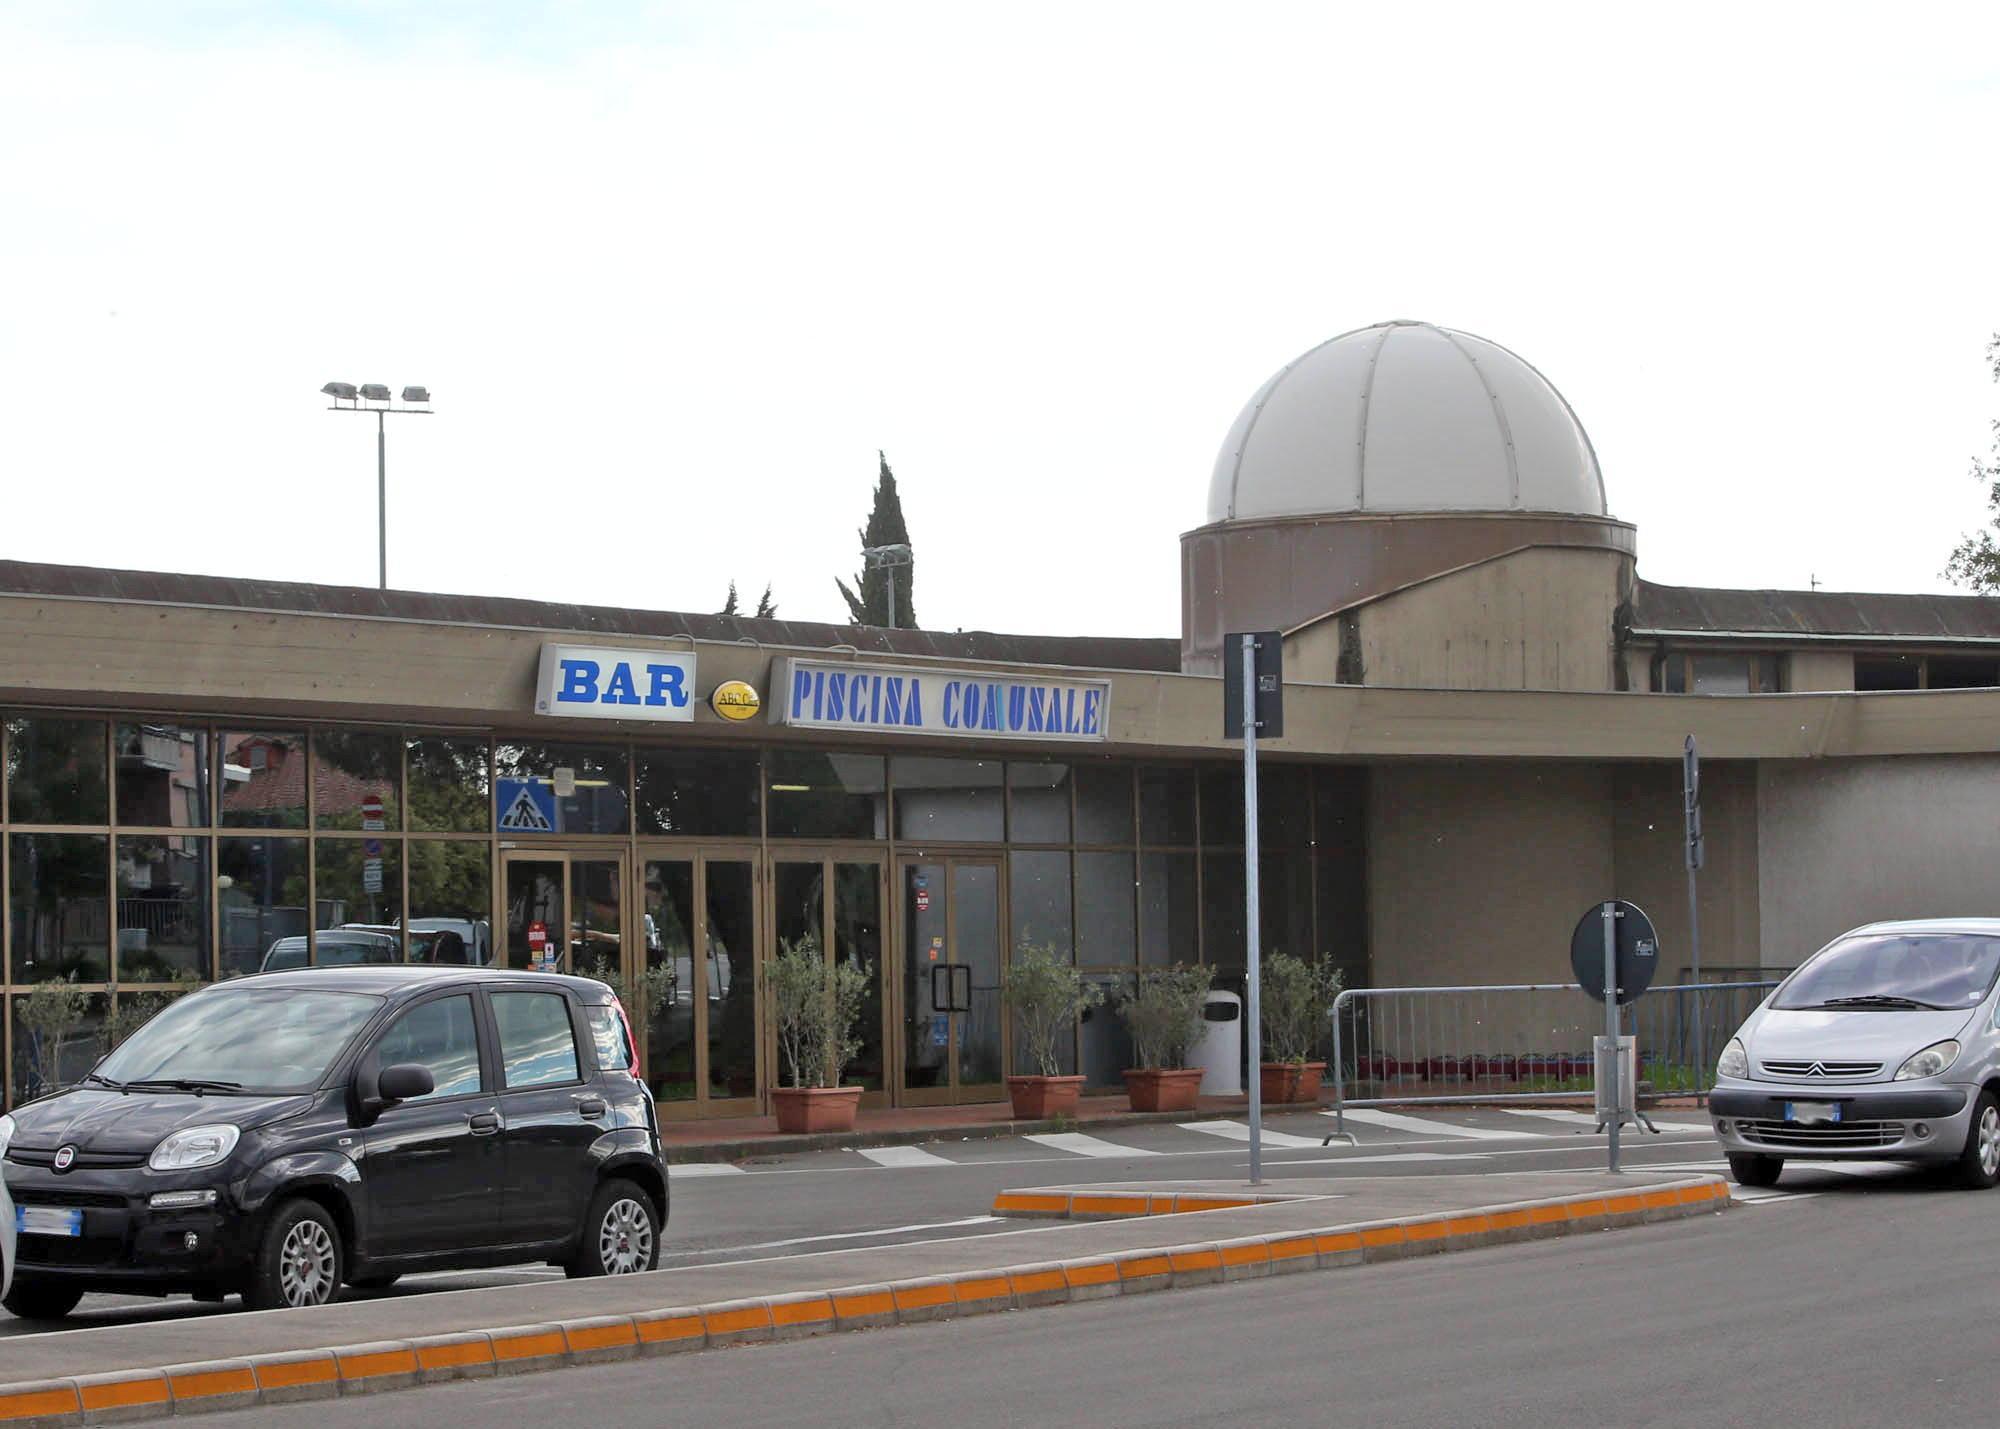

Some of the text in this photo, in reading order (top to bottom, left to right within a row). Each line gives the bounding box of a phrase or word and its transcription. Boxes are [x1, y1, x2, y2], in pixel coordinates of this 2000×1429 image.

[557, 659, 689, 708] BAR
[792, 670, 1100, 734] PISCINA COMUNALE
